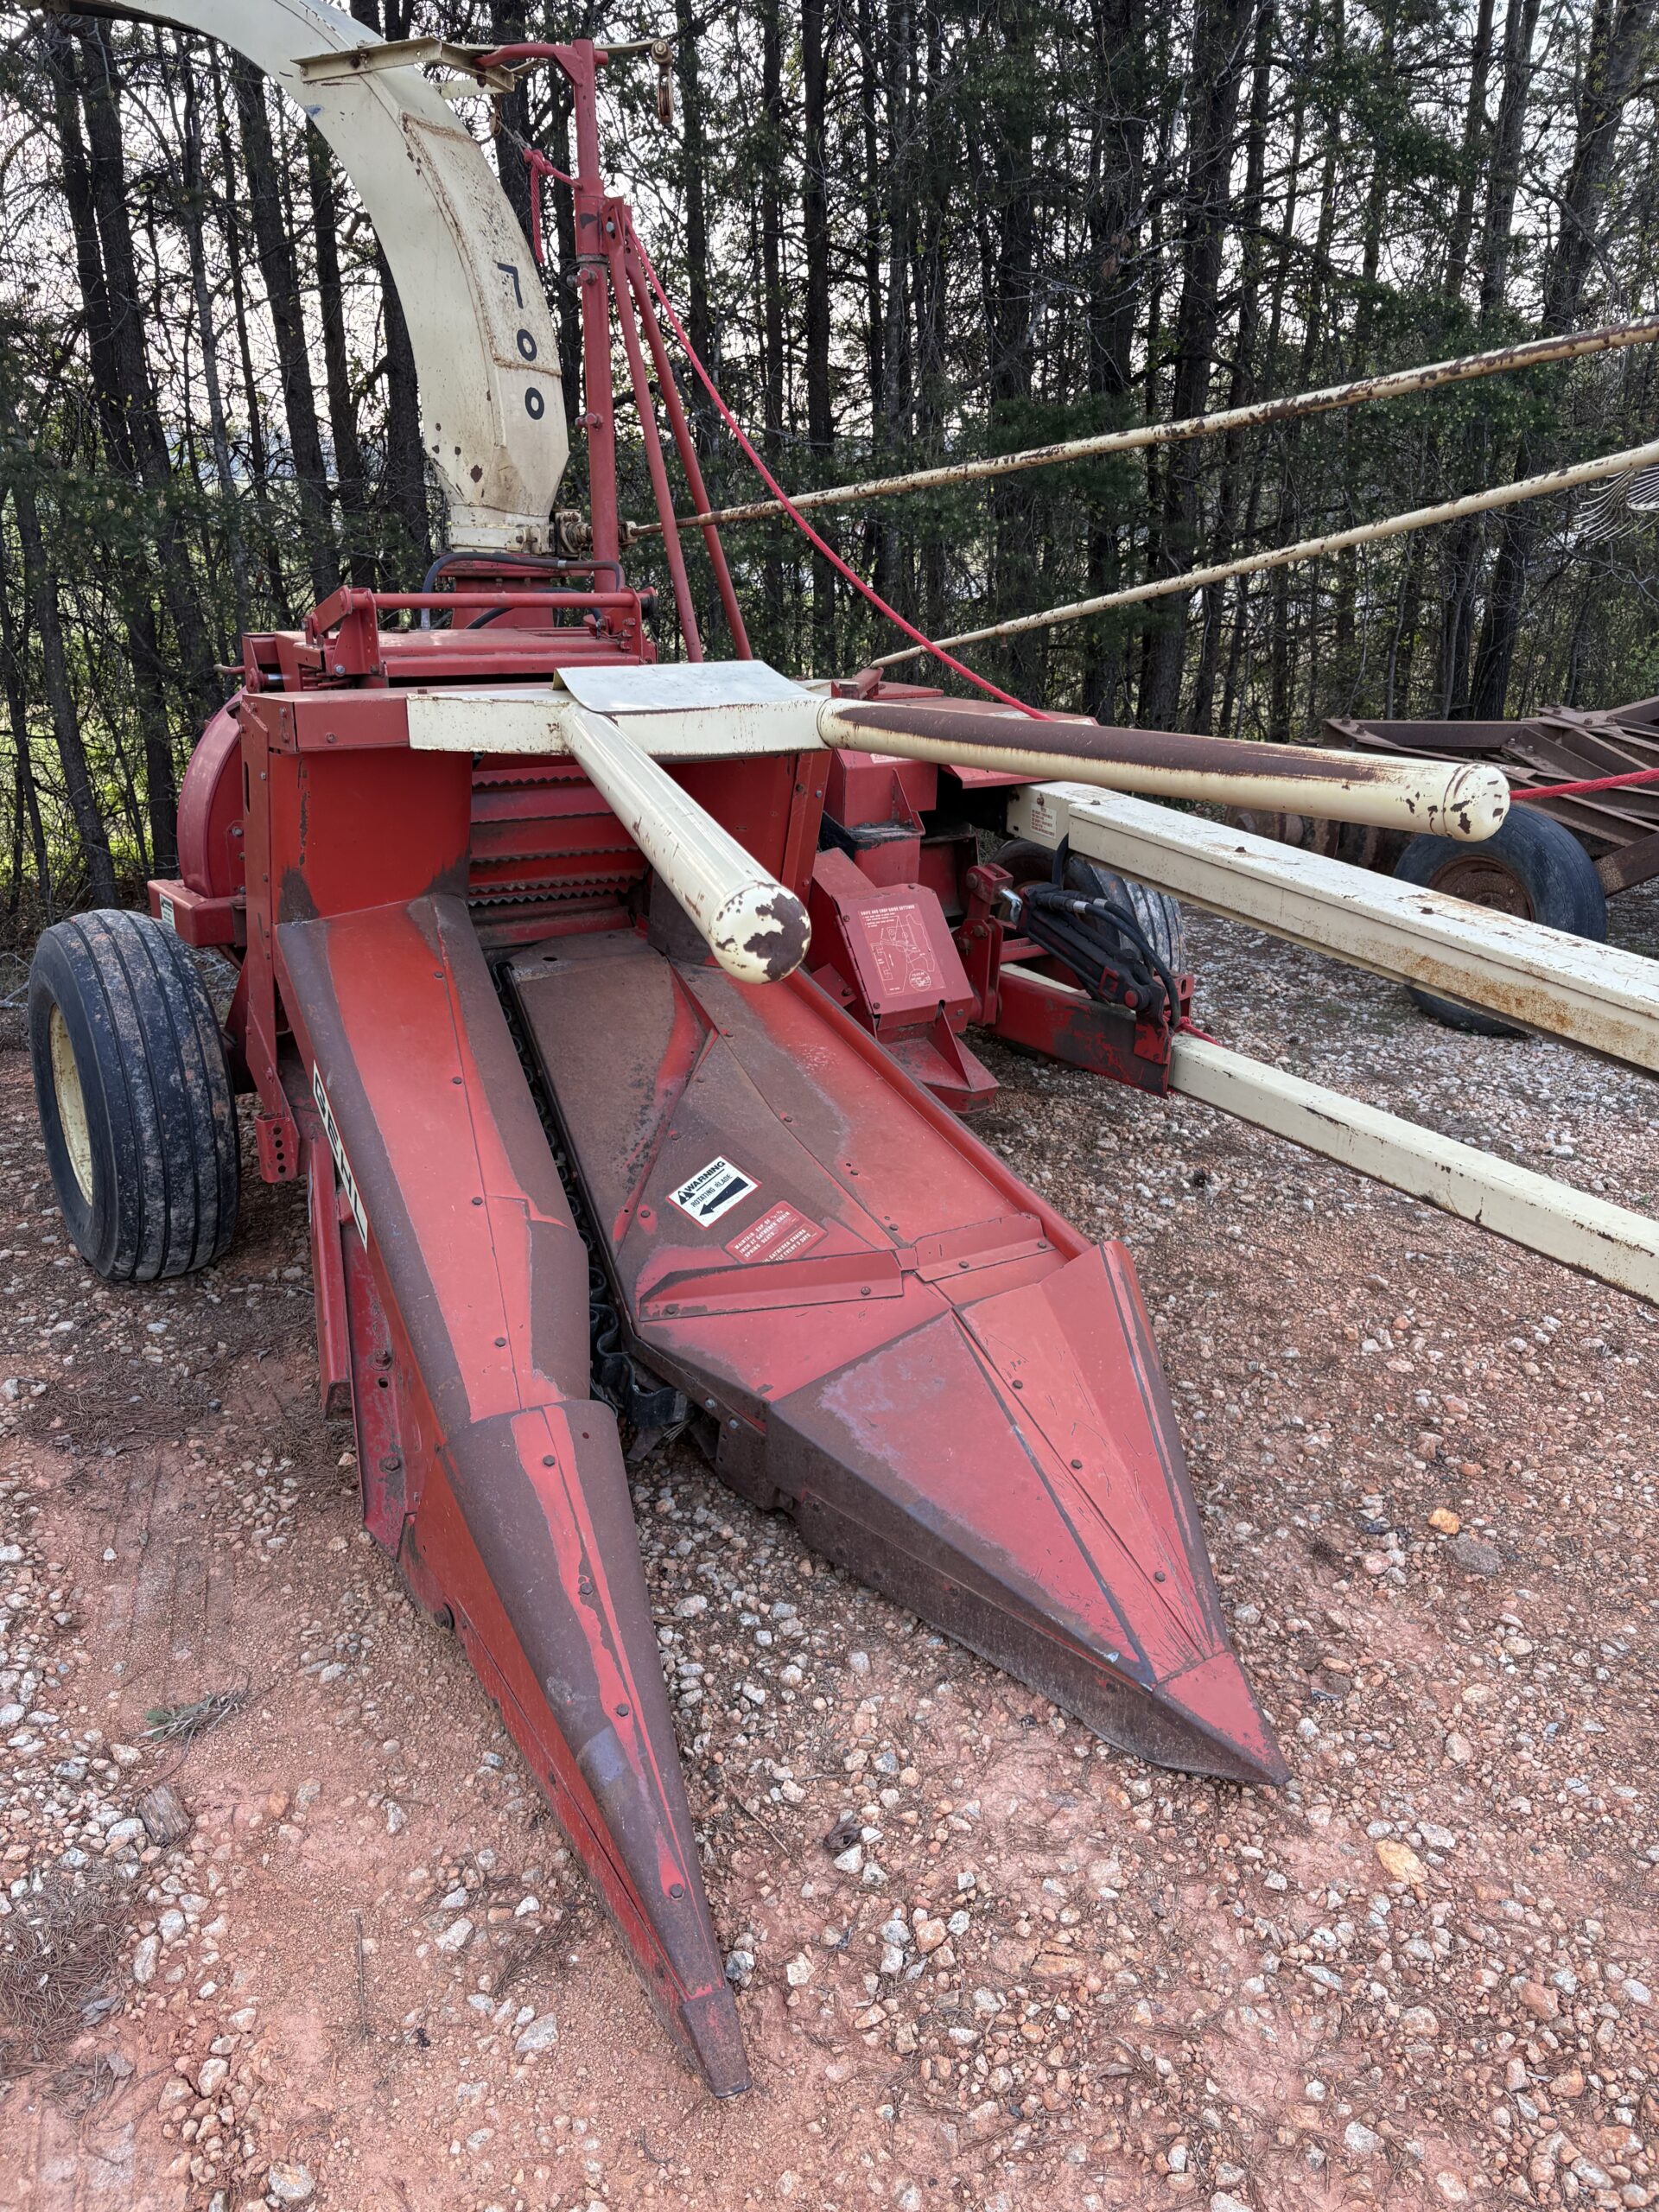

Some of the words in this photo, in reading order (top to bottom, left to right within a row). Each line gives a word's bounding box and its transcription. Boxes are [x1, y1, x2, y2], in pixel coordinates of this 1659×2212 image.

[497, 262, 545, 421] 700
[315, 1071, 366, 1241] GEHL
[684, 1160, 726, 1192] WARNING
[690, 1187, 716, 1208] ROTATING
[715, 1173, 733, 1189] BLADE
[734, 1232, 755, 1249] MAINTAIN
[740, 1243, 751, 1254] INCH
[776, 1211, 791, 1224] CHAIN
[790, 1229, 806, 1243] CHAINS
[744, 1243, 760, 1258] SPRING
